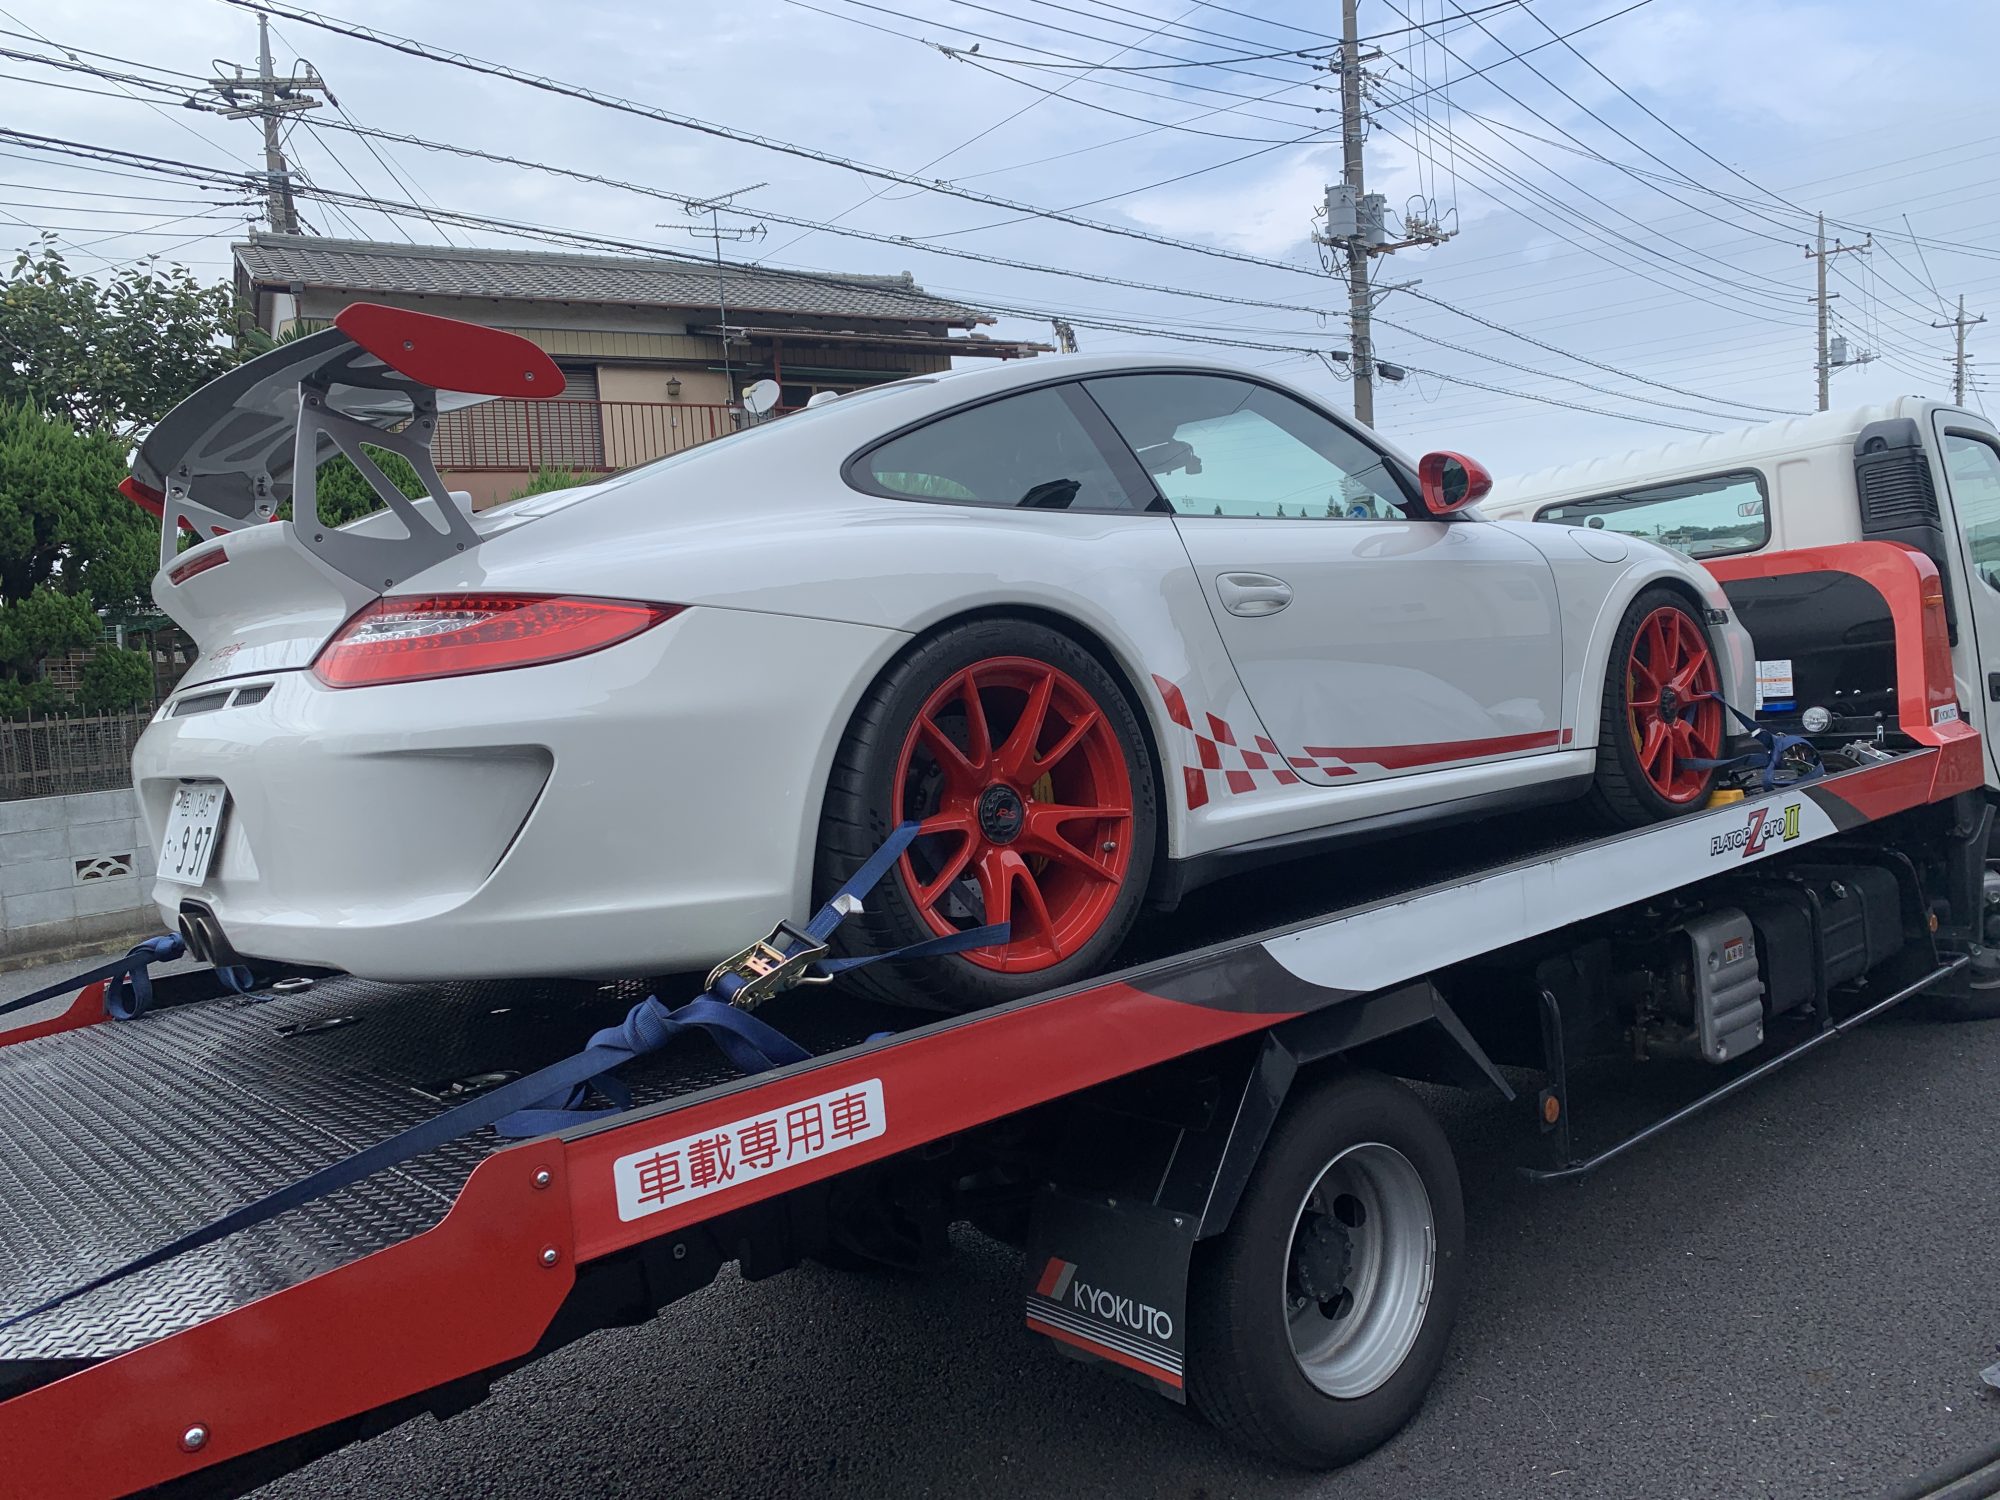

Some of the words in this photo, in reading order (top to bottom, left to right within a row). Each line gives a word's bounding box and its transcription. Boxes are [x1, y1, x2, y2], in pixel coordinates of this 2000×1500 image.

[1710, 827, 1752, 856] FLATOP
[1742, 807, 1785, 858] Zero
[634, 1092, 871, 1204] 車載専用車
[1074, 1280, 1173, 1340] KYOKUTO
